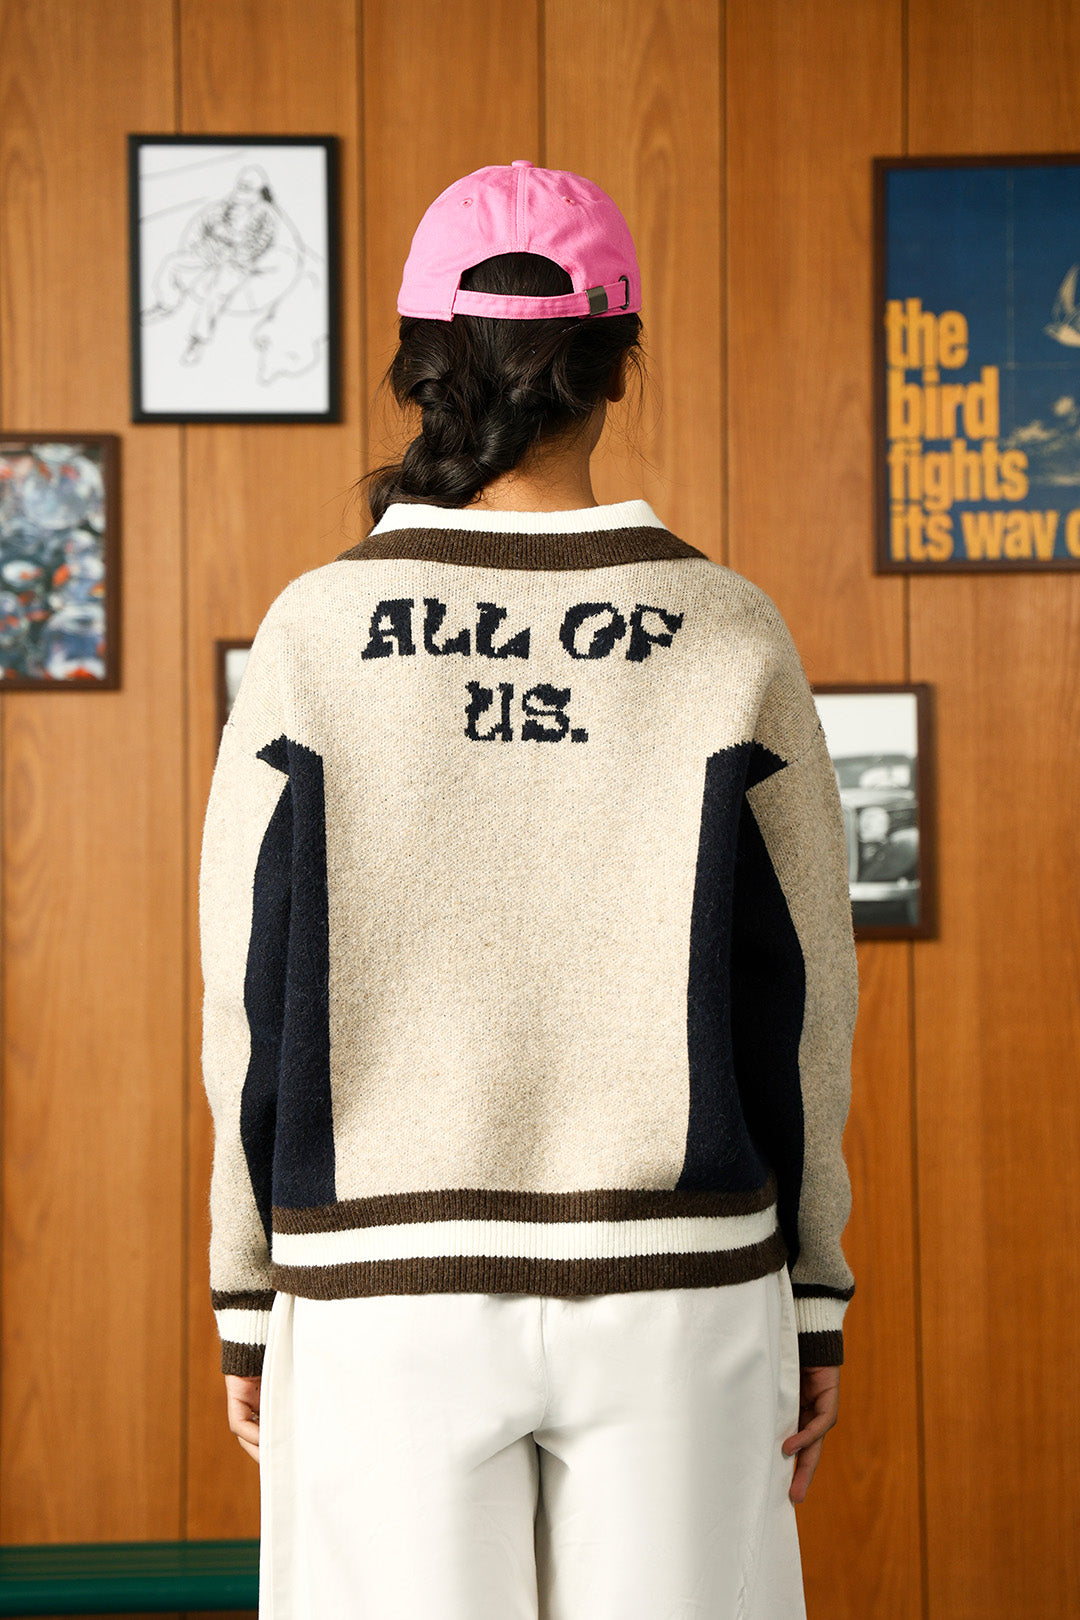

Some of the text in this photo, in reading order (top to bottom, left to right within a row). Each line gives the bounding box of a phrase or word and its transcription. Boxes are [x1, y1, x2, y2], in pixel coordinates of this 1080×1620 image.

[886, 298, 969, 369] the
[887, 365, 999, 439] bird
[887, 438, 1029, 513] fights
[889, 504, 955, 561] its
[361, 598, 685, 662] ALL OF
[464, 680, 589, 743] US.
